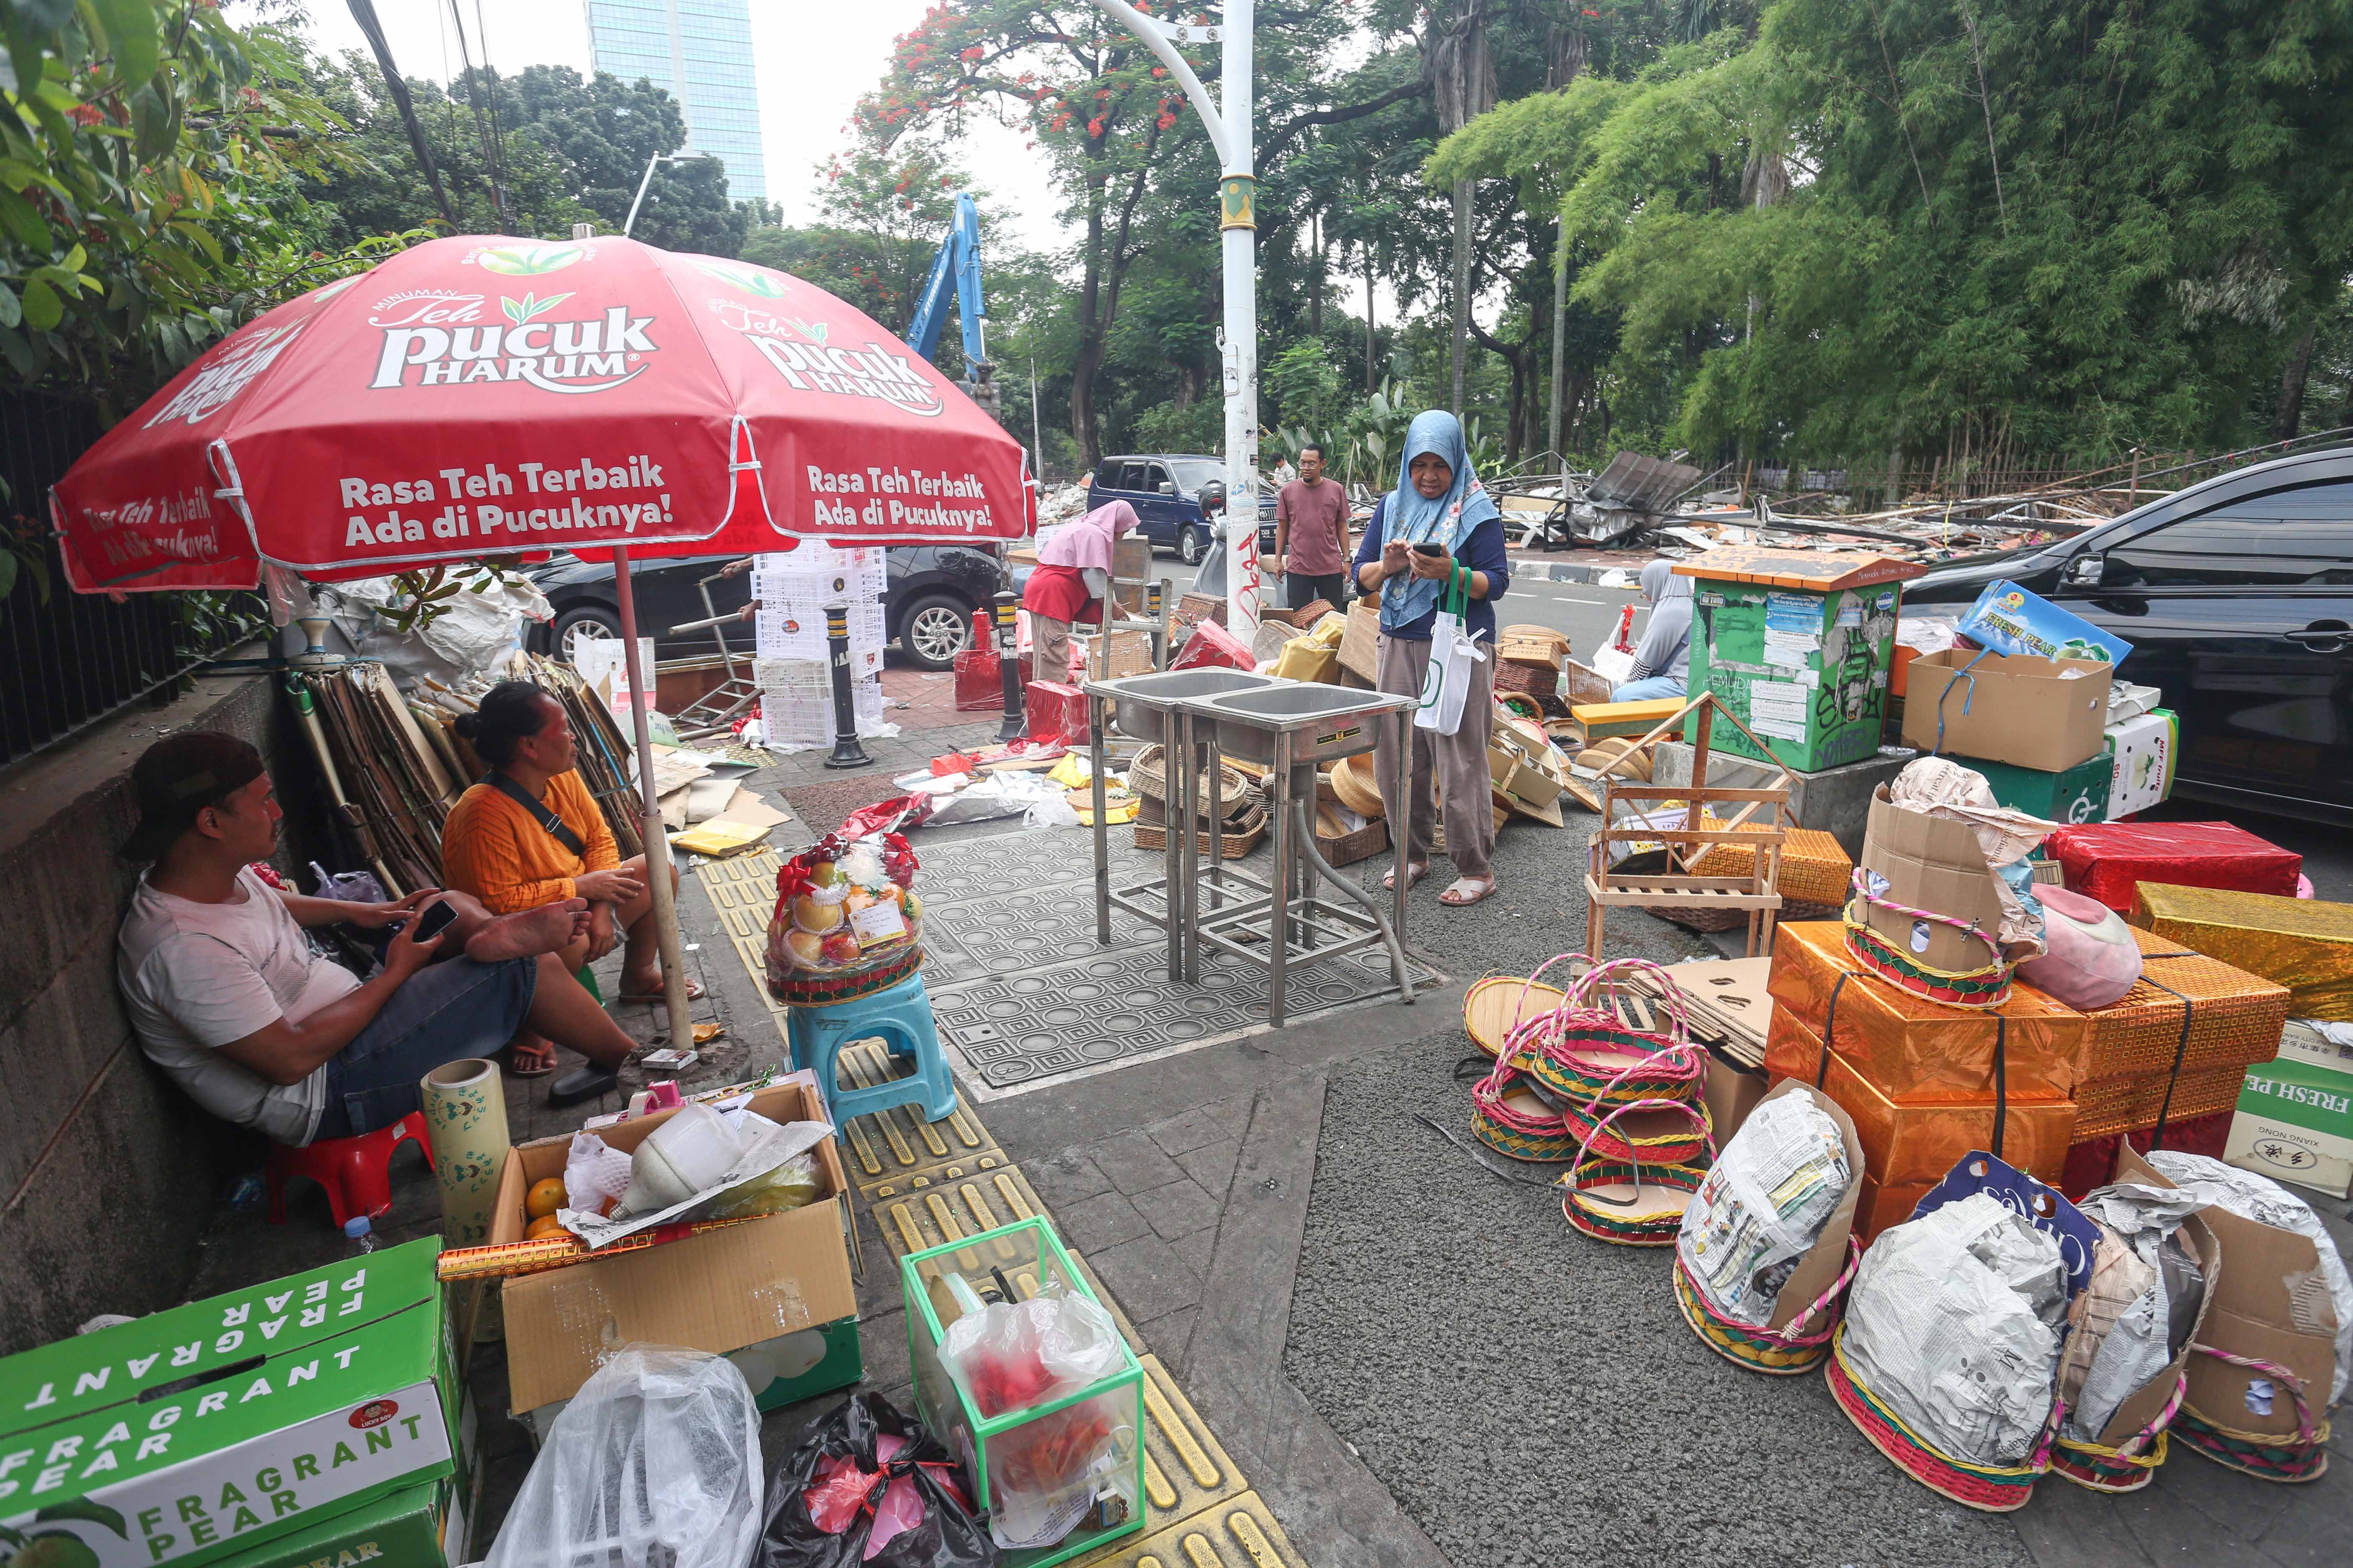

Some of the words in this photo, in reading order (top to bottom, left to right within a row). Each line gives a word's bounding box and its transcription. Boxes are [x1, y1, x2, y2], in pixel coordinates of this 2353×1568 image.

[372, 289, 458, 311] MINUMAN
[924, 268, 943, 316] HYUNDAI
[368, 294, 485, 327] Teh
[721, 304, 792, 337] Teh
[417, 352, 627, 386] HARUM
[807, 370, 936, 405] HARUM
[339, 476, 436, 509] Rasa
[439, 463, 515, 500] Teh
[519, 454, 665, 493] Terbaik
[806, 465, 864, 494] Rasa
[867, 466, 908, 494] Teh
[910, 469, 985, 500] Terbaik
[118, 497, 154, 524] Teh
[159, 486, 212, 524] Terbaik
[345, 513, 426, 547] Ada
[431, 504, 469, 539] di
[477, 493, 674, 535] Pucuknya!
[814, 498, 858, 526] Ada
[862, 500, 884, 525] di
[889, 499, 993, 532] Pucuknya!
[1985, 612, 2024, 639] FRESH
[2023, 632, 2057, 657] PEAR
[1334, 965, 1372, 985] JAKARTA
[2245, 1074, 2274, 1095] PE
[2277, 1082, 2351, 1114] FRESH
[2258, 1126, 2287, 1139] NONG
[2290, 1134, 2319, 1148] XIANG
[1804, 1215, 1816, 1228] BEI
[222, 1268, 367, 1328] PEAR
[24, 1291, 365, 1411] FRAGRANT
[0, 1344, 360, 1479] FRAGRANT
[361, 1418, 380, 1428] LUCKY
[137, 1413, 422, 1535] FRAGRANT
[147, 1490, 302, 1562] PEAR
